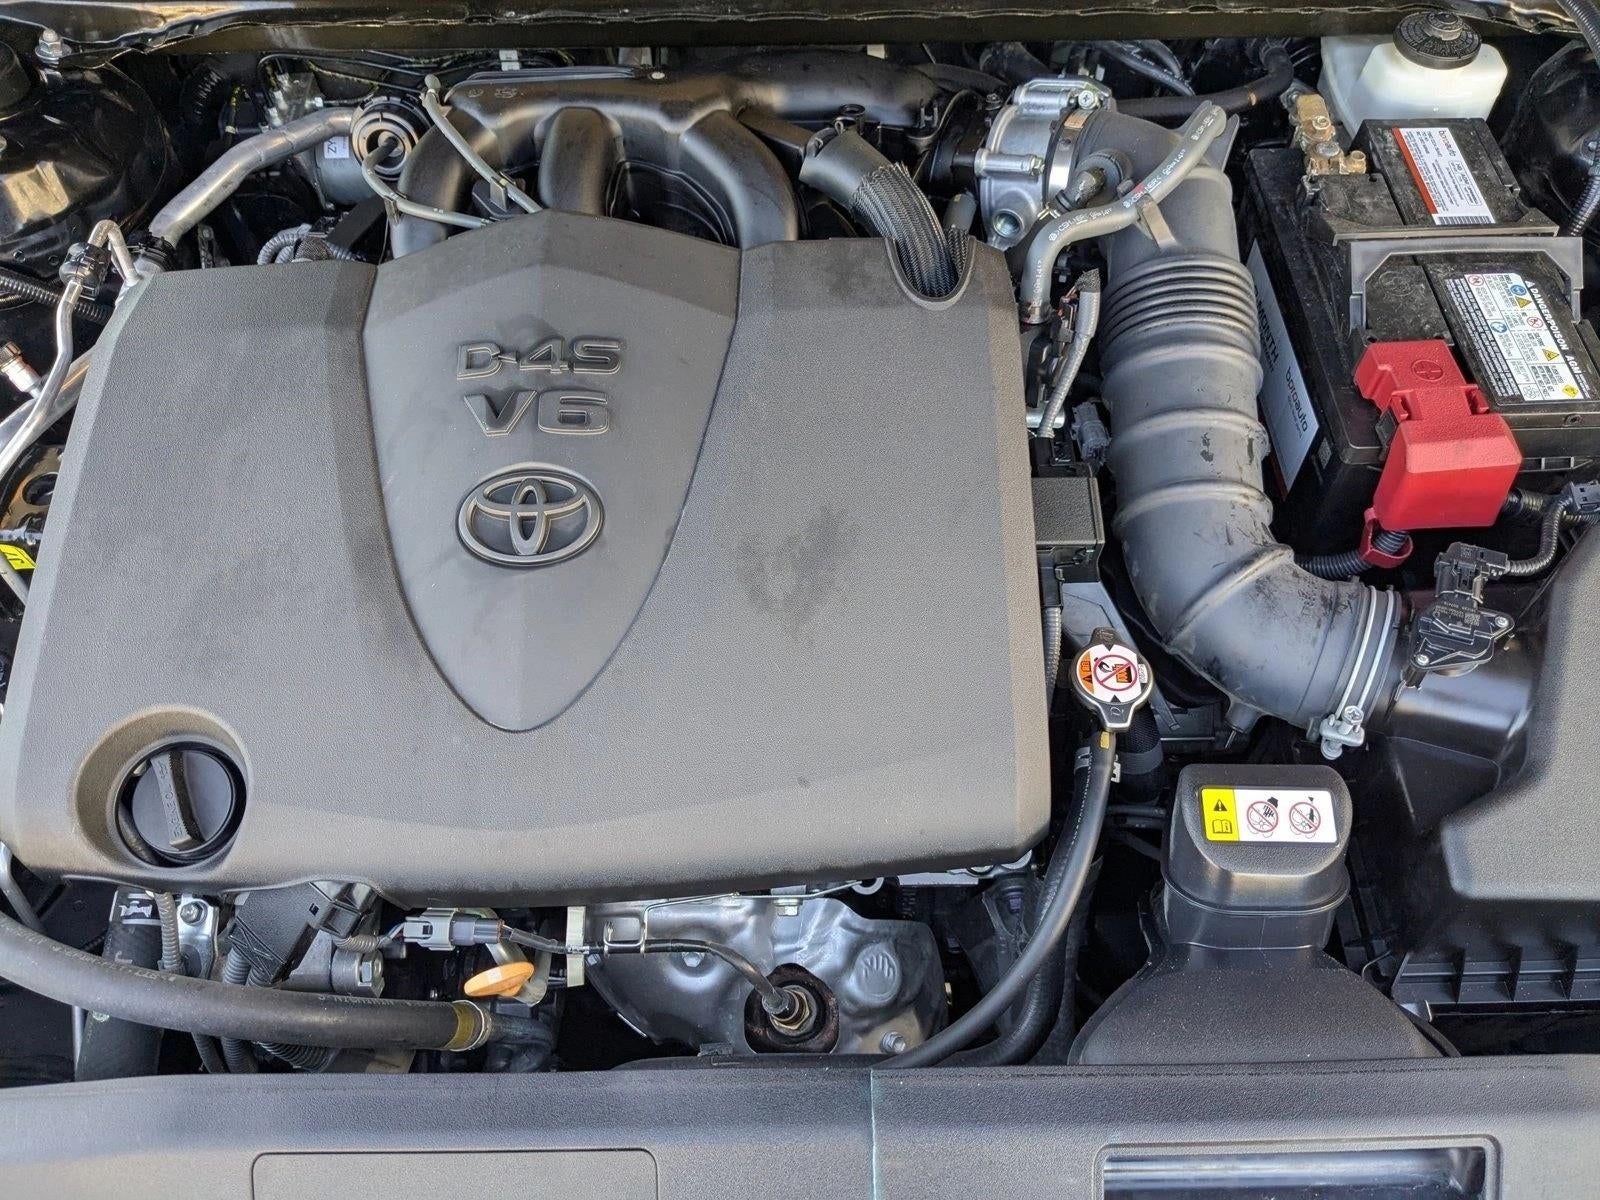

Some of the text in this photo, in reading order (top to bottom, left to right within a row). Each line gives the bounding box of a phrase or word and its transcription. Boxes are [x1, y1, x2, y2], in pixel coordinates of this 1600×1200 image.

[1529, 287, 1570, 352] DANGER/POISON
[456, 335, 623, 381] D-4S
[463, 389, 609, 437] V6
